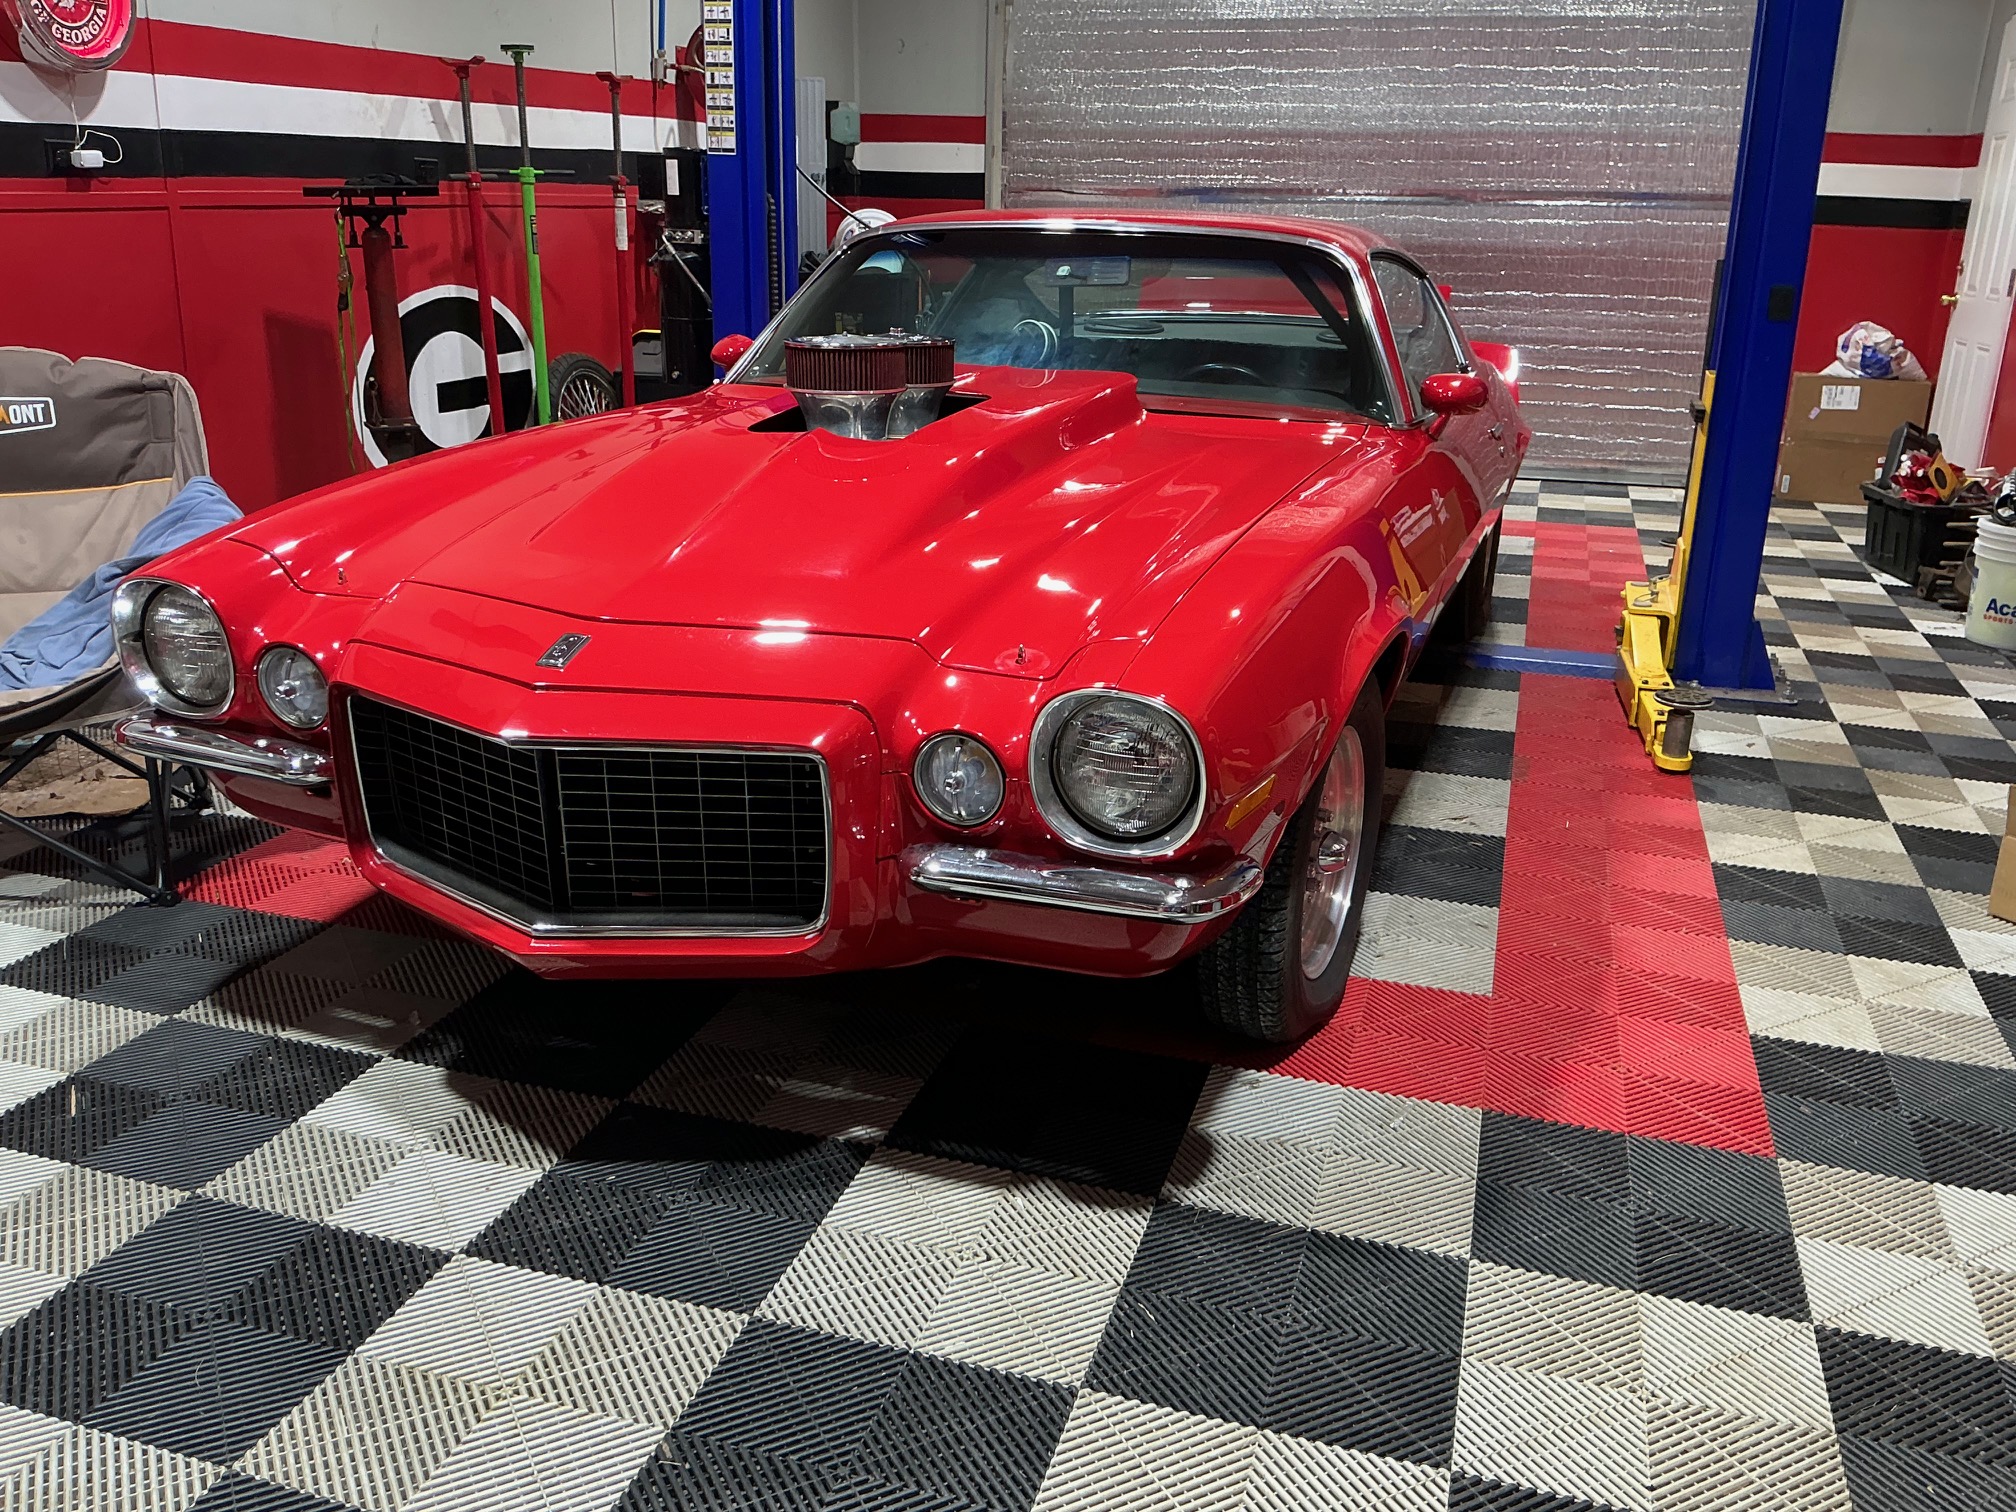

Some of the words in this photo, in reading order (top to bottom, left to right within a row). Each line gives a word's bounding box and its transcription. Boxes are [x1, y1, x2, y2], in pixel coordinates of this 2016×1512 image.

[51, 8, 107, 44] GEORGIA
[363, 295, 533, 463] G
[1983, 613, 2014, 625] SPORTS
